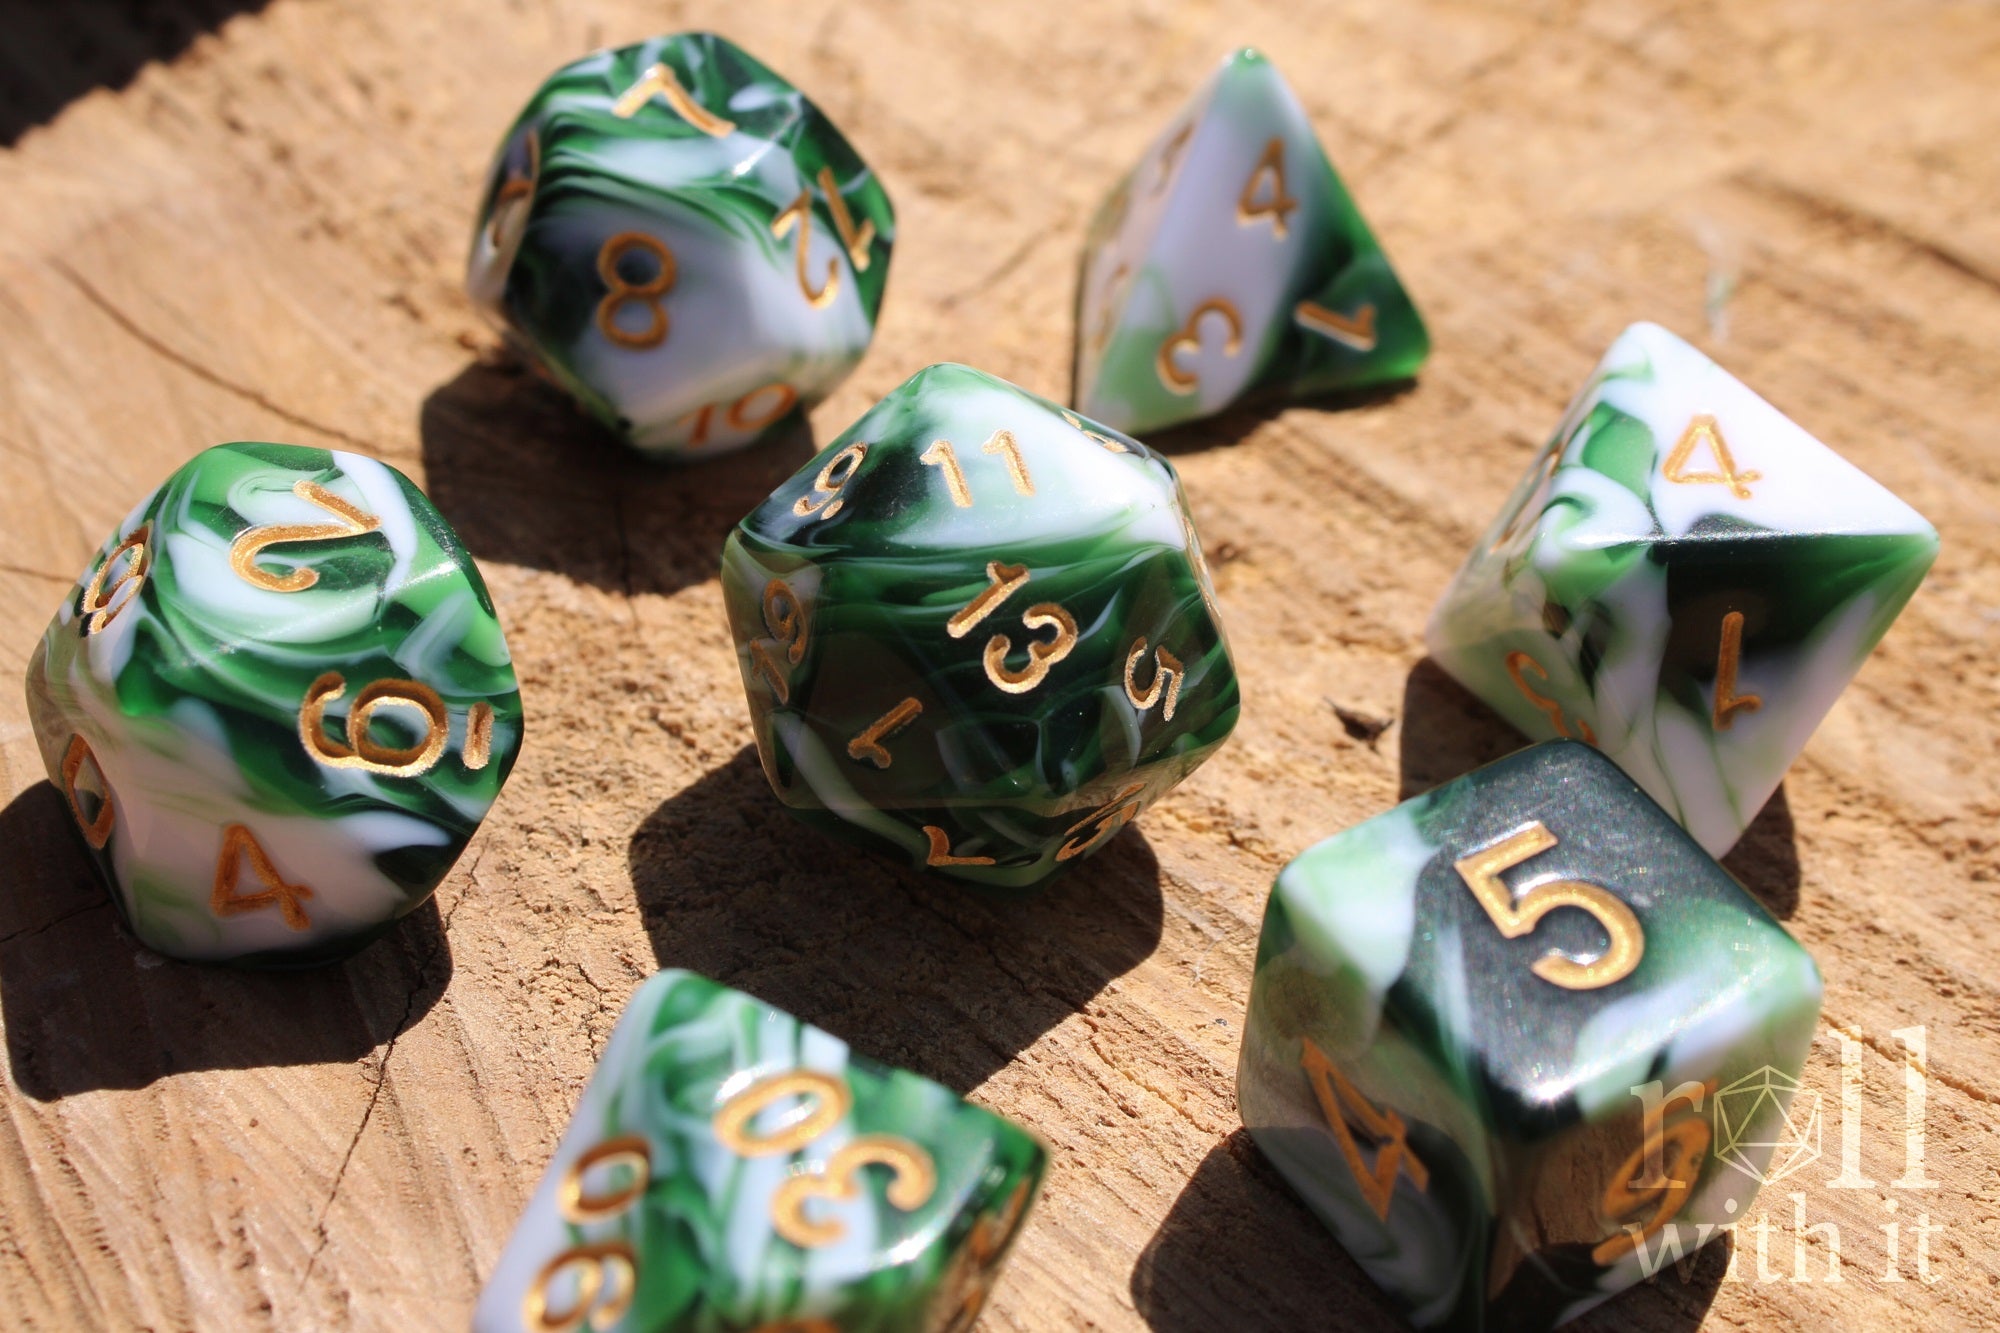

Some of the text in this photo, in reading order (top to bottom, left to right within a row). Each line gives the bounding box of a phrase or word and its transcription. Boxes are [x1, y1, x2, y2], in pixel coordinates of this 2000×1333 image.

[613, 62, 736, 138] 7
[771, 167, 876, 309] 12
[1236, 136, 1297, 241] 4
[597, 231, 678, 352] 8
[1295, 302, 1377, 352] 1
[1157, 296, 1243, 396] 3
[680, 384, 797, 448] 10
[921, 430, 1036, 508] 11
[1662, 414, 1762, 500] 4
[82, 525, 150, 634] 8
[947, 561, 1078, 694] 13
[750, 578, 808, 704] 19
[1124, 636, 1185, 721] 5
[1712, 612, 1762, 731] 1
[848, 697, 923, 769] 1
[212, 823, 314, 931] 4
[1454, 819, 1645, 990] 5
[713, 1069, 937, 1248] 30
[1301, 1036, 1430, 1222] 4
